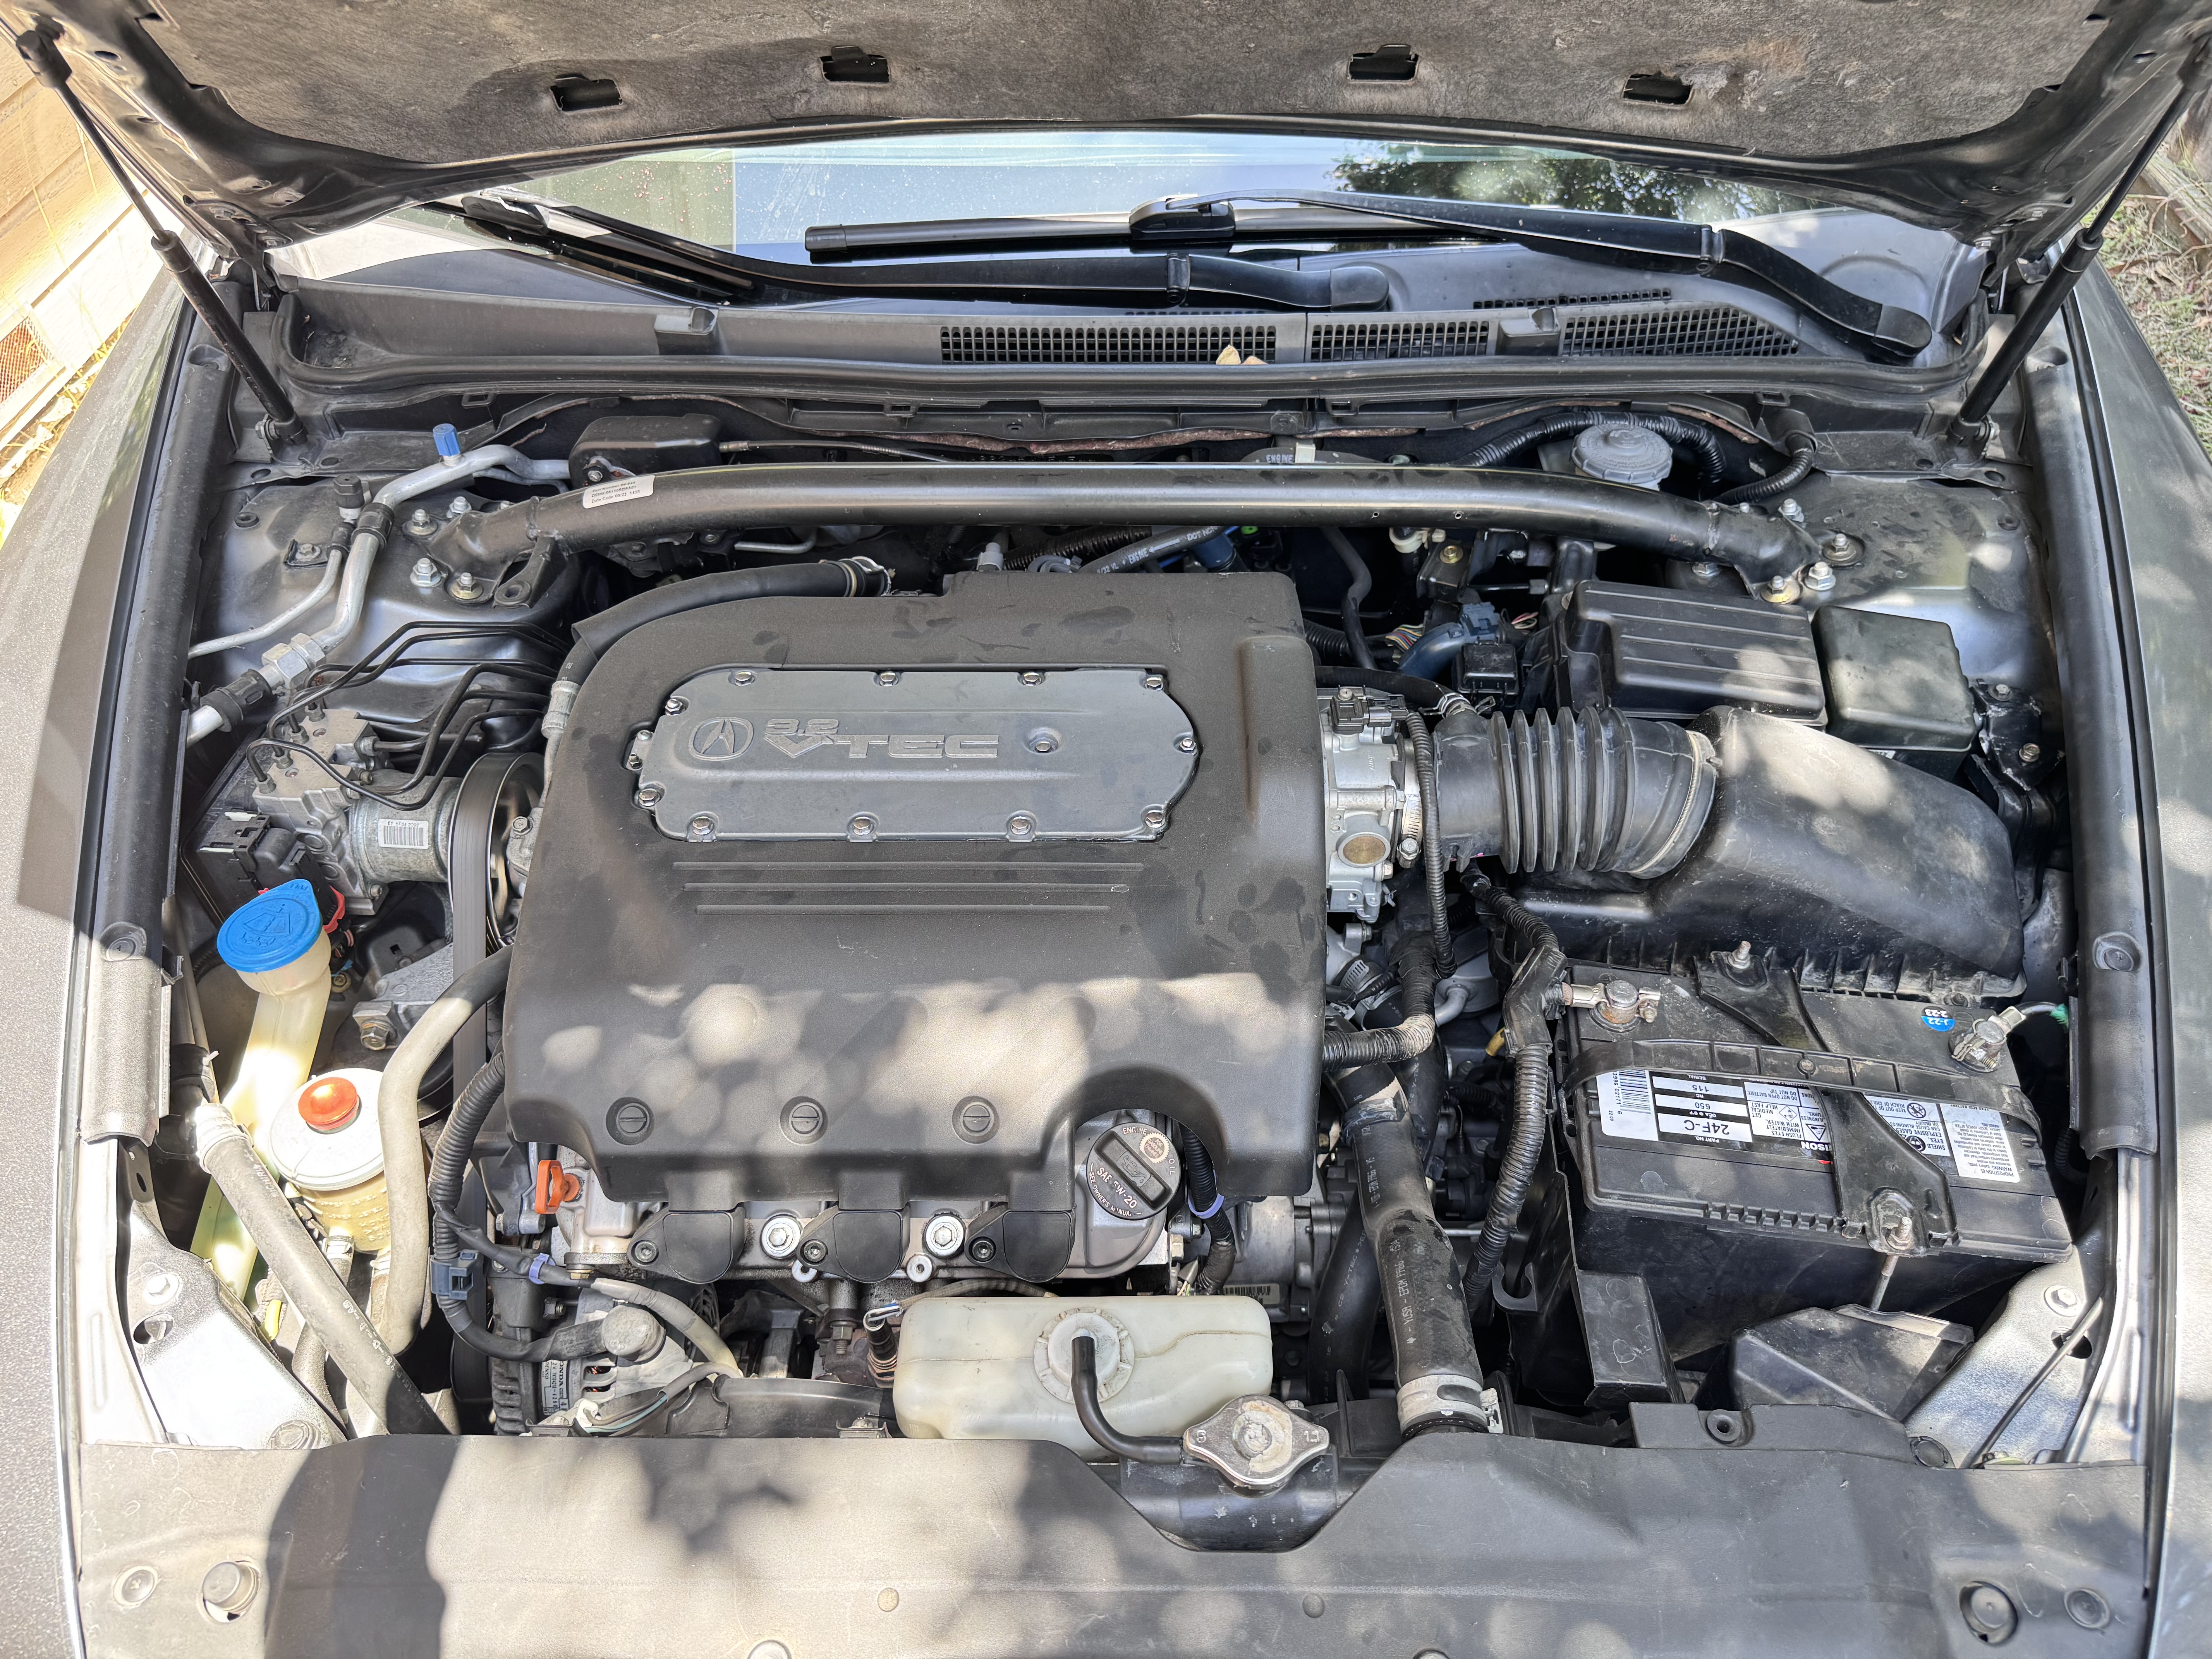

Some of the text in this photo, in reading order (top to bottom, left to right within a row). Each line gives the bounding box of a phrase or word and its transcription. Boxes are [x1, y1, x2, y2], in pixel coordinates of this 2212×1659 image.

[765, 718, 840, 735] 3.2
[763, 734, 999, 759] VTEC
[1925, 1009, 1948, 1018] 2-23
[1683, 1120, 1729, 1135] 24F-C
[1097, 1167, 1112, 1183] SAE
[1111, 1205, 1132, 1217] MNUA
[1338, 1293, 1345, 1307] C2
[1343, 1254, 1357, 1285] Y-TEC
[1399, 1278, 1409, 1297] EPDM
[1402, 1305, 1413, 1327] YUSA
[1304, 1430, 1320, 1443] 1.1
